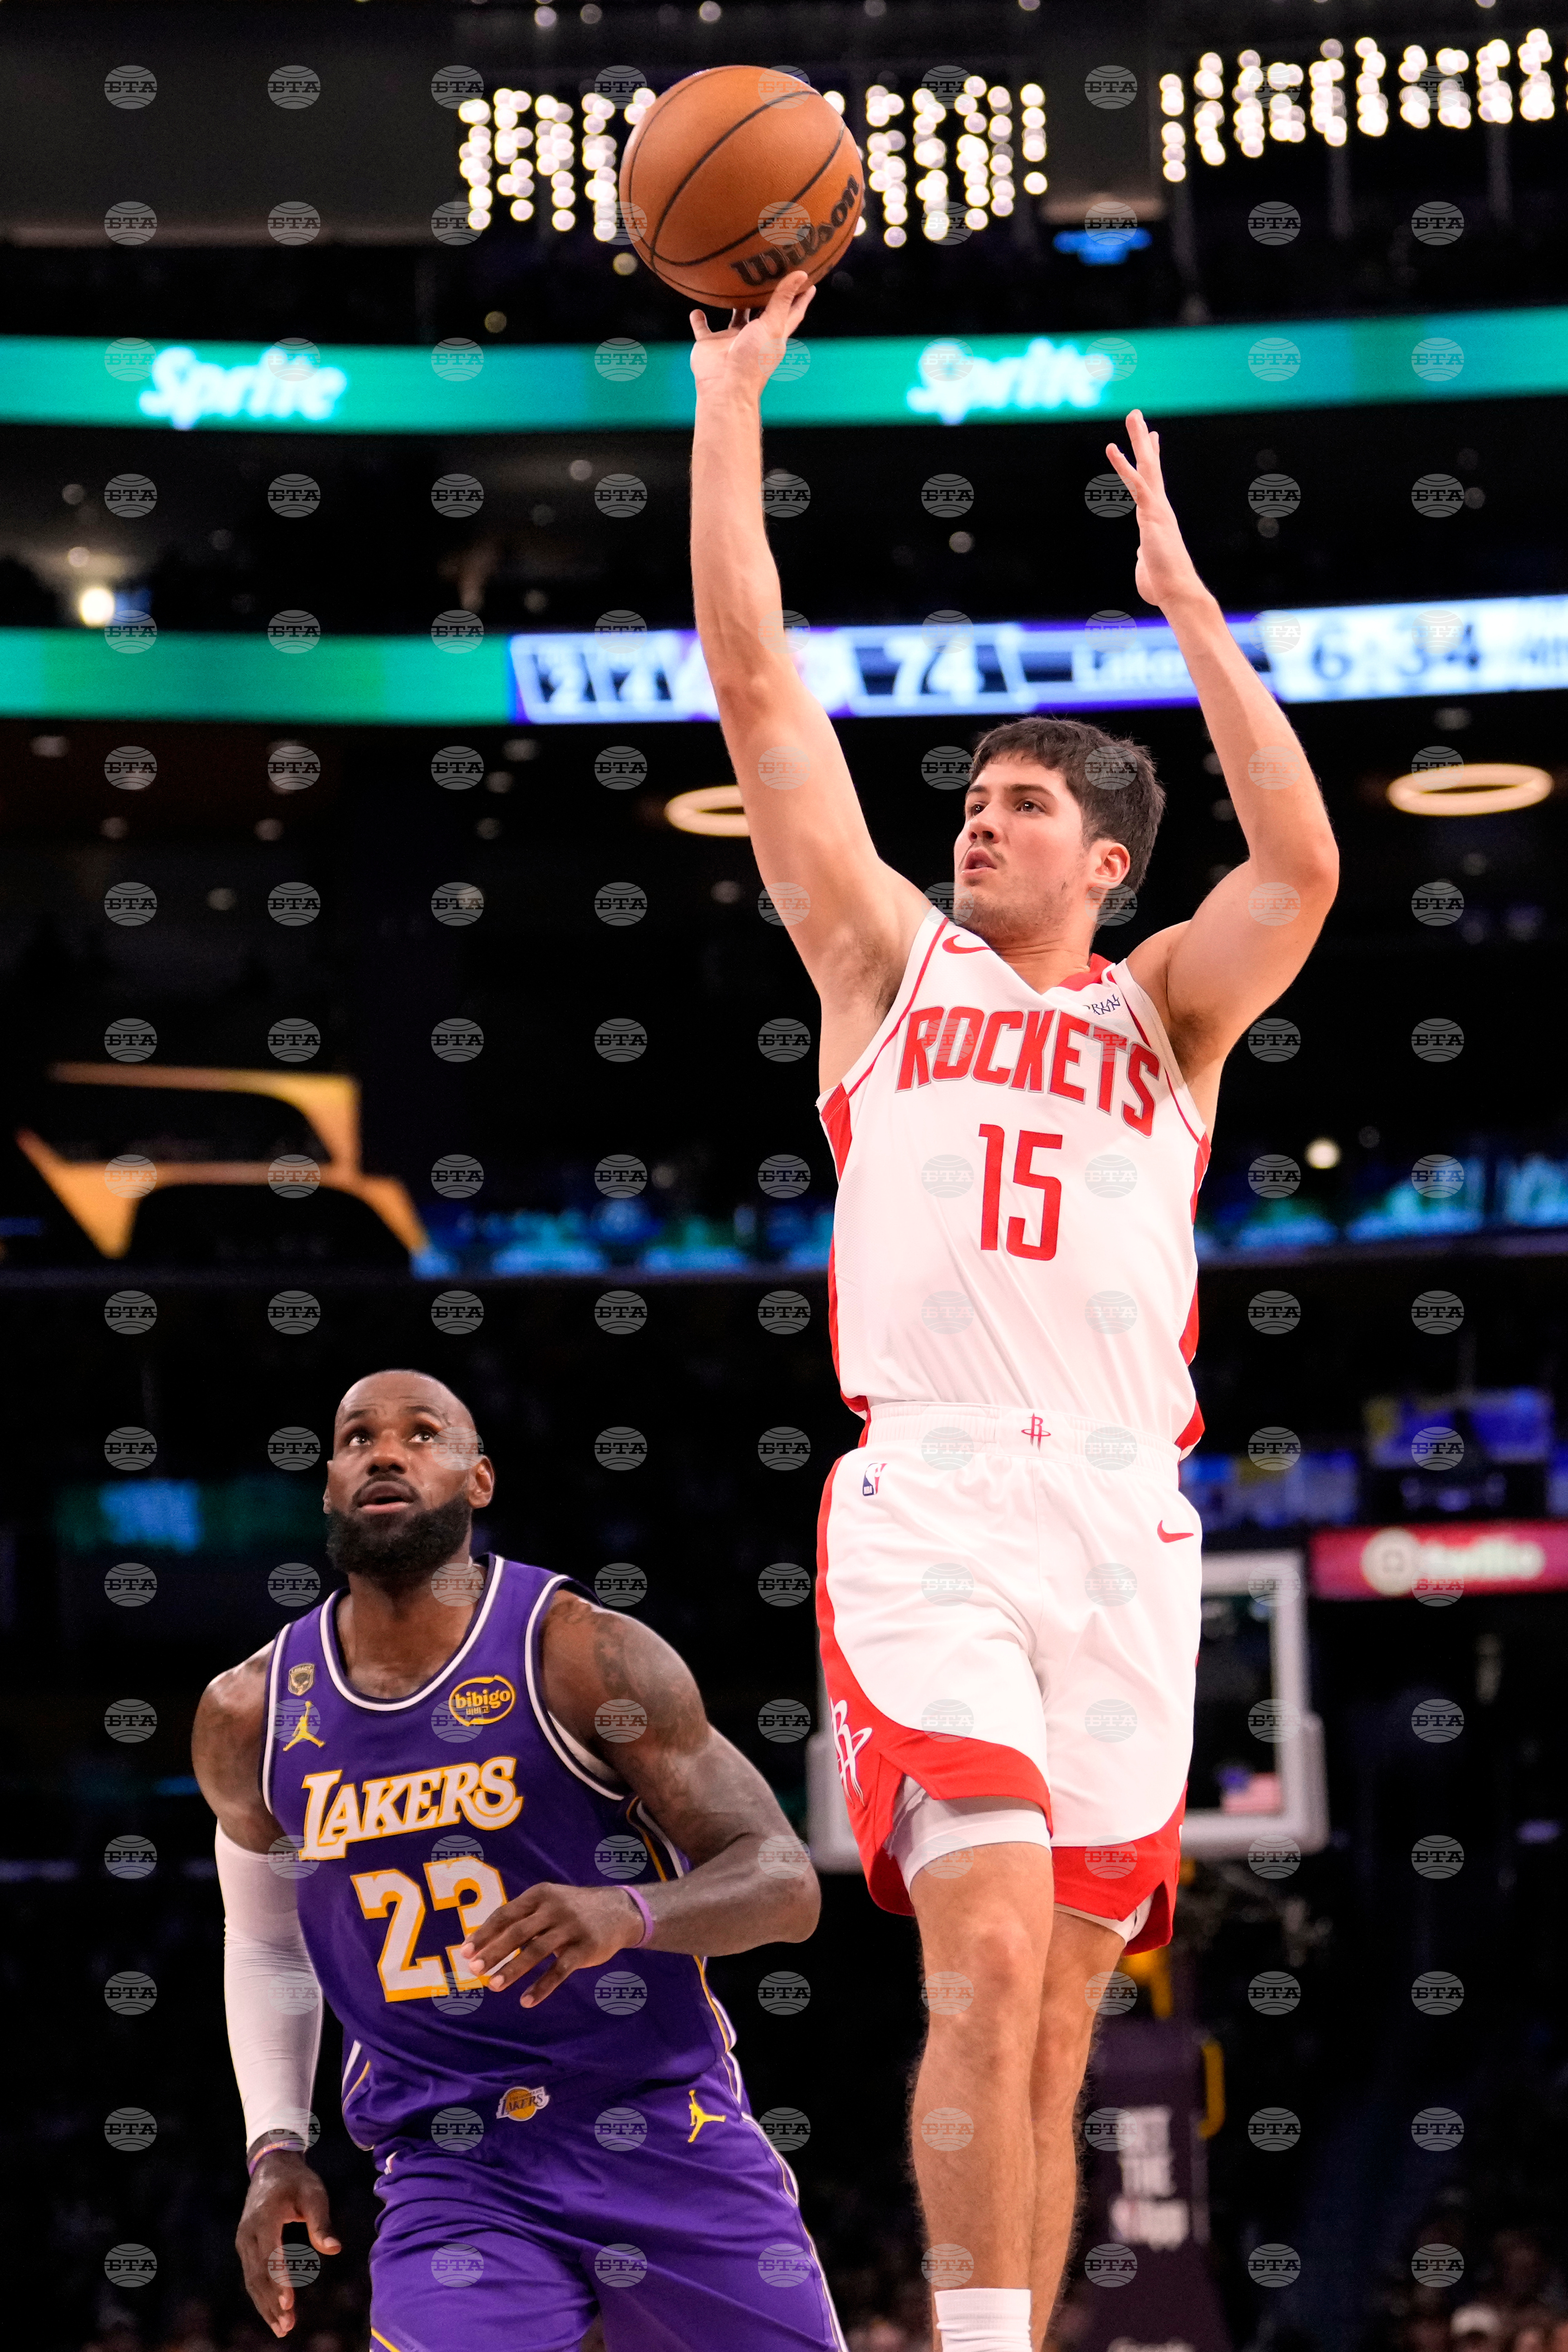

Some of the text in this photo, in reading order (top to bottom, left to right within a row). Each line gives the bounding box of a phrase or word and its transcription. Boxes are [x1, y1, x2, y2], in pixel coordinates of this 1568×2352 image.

[729, 174, 859, 287] Wilson
[138, 346, 347, 430] Sprite
[907, 338, 1114, 425] Sprite
[895, 1005, 1160, 1139] ROCKETS
[978, 1123, 1063, 1262] 15
[455, 1689, 511, 1709] bibigo
[466, 1706, 490, 1716] 비비고
[298, 1756, 523, 1861] LAKERS
[350, 1855, 521, 2003] 23
